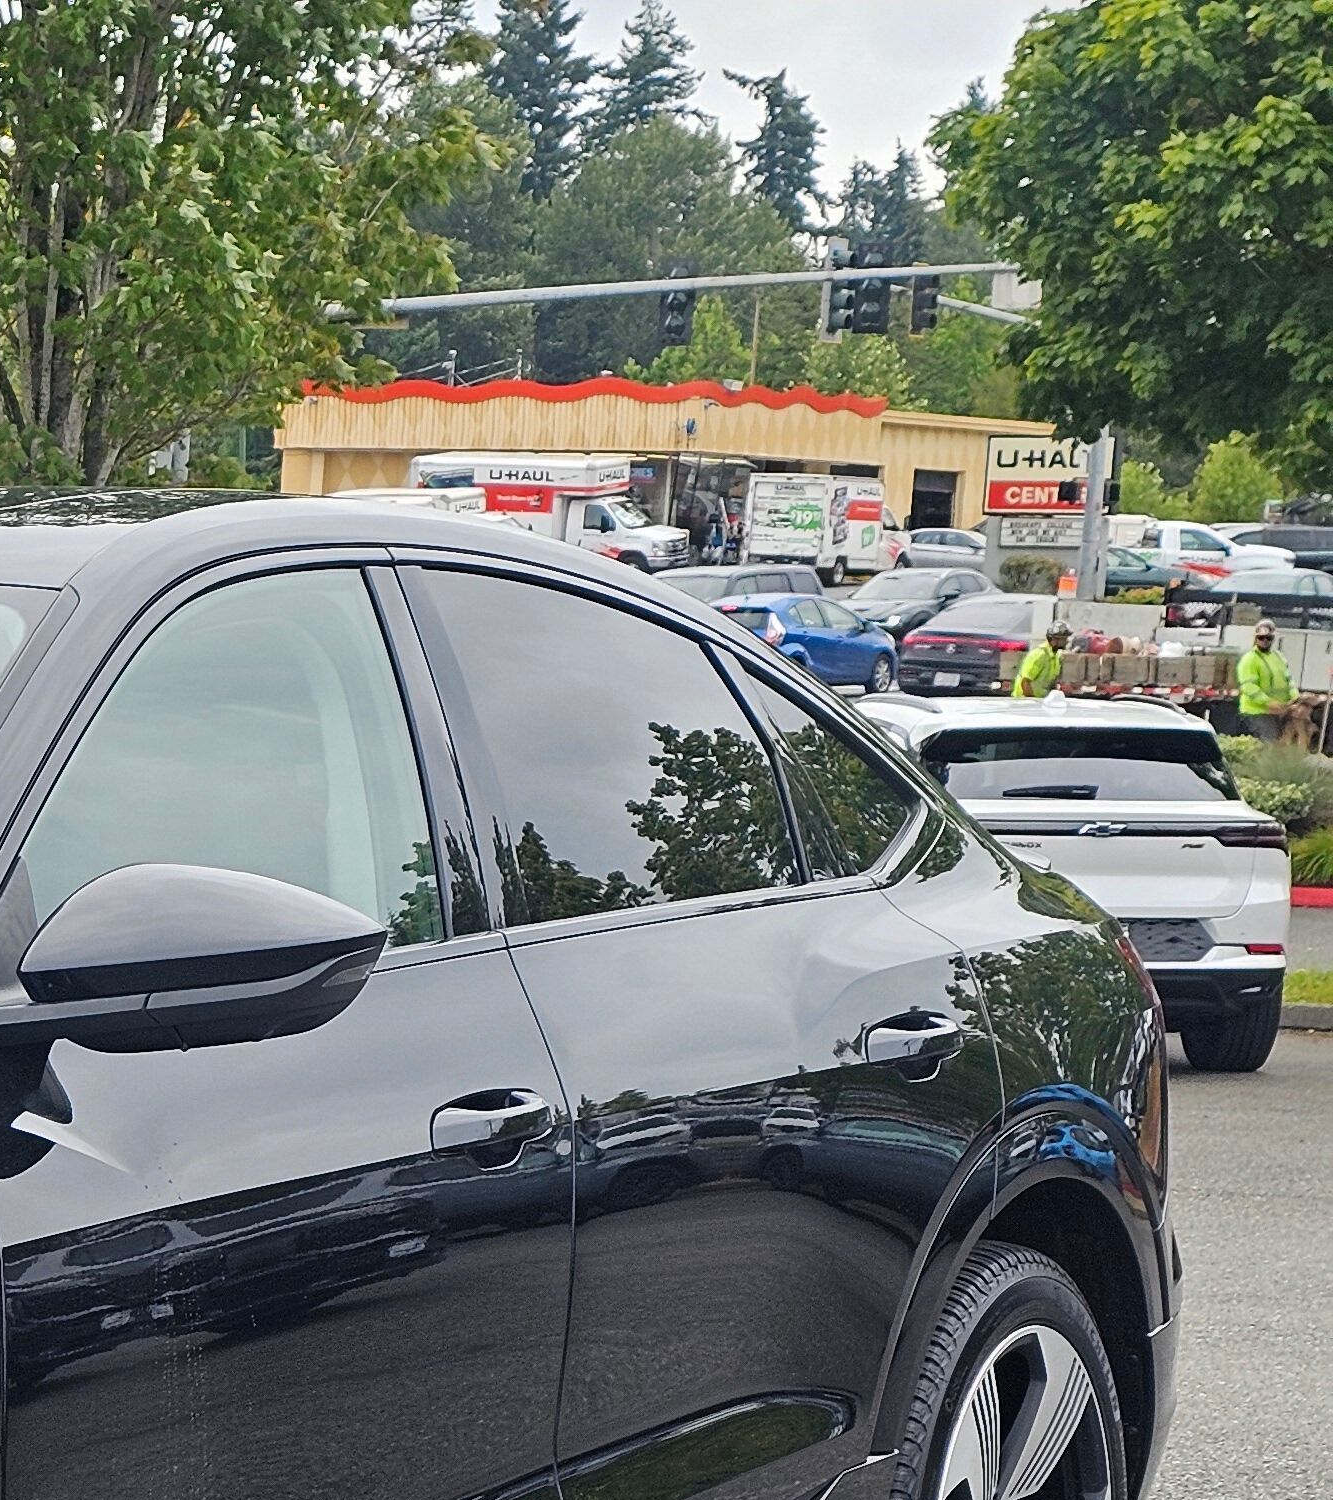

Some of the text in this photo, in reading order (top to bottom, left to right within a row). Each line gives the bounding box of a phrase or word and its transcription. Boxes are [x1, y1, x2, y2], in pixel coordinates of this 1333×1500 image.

[997, 449, 1089, 468] U-HAU
[490, 470, 554, 482] U-HAUL
[599, 469, 626, 483] U-HAUL
[1005, 486, 1087, 505] CENT
[455, 501, 482, 513] U-HAUL
